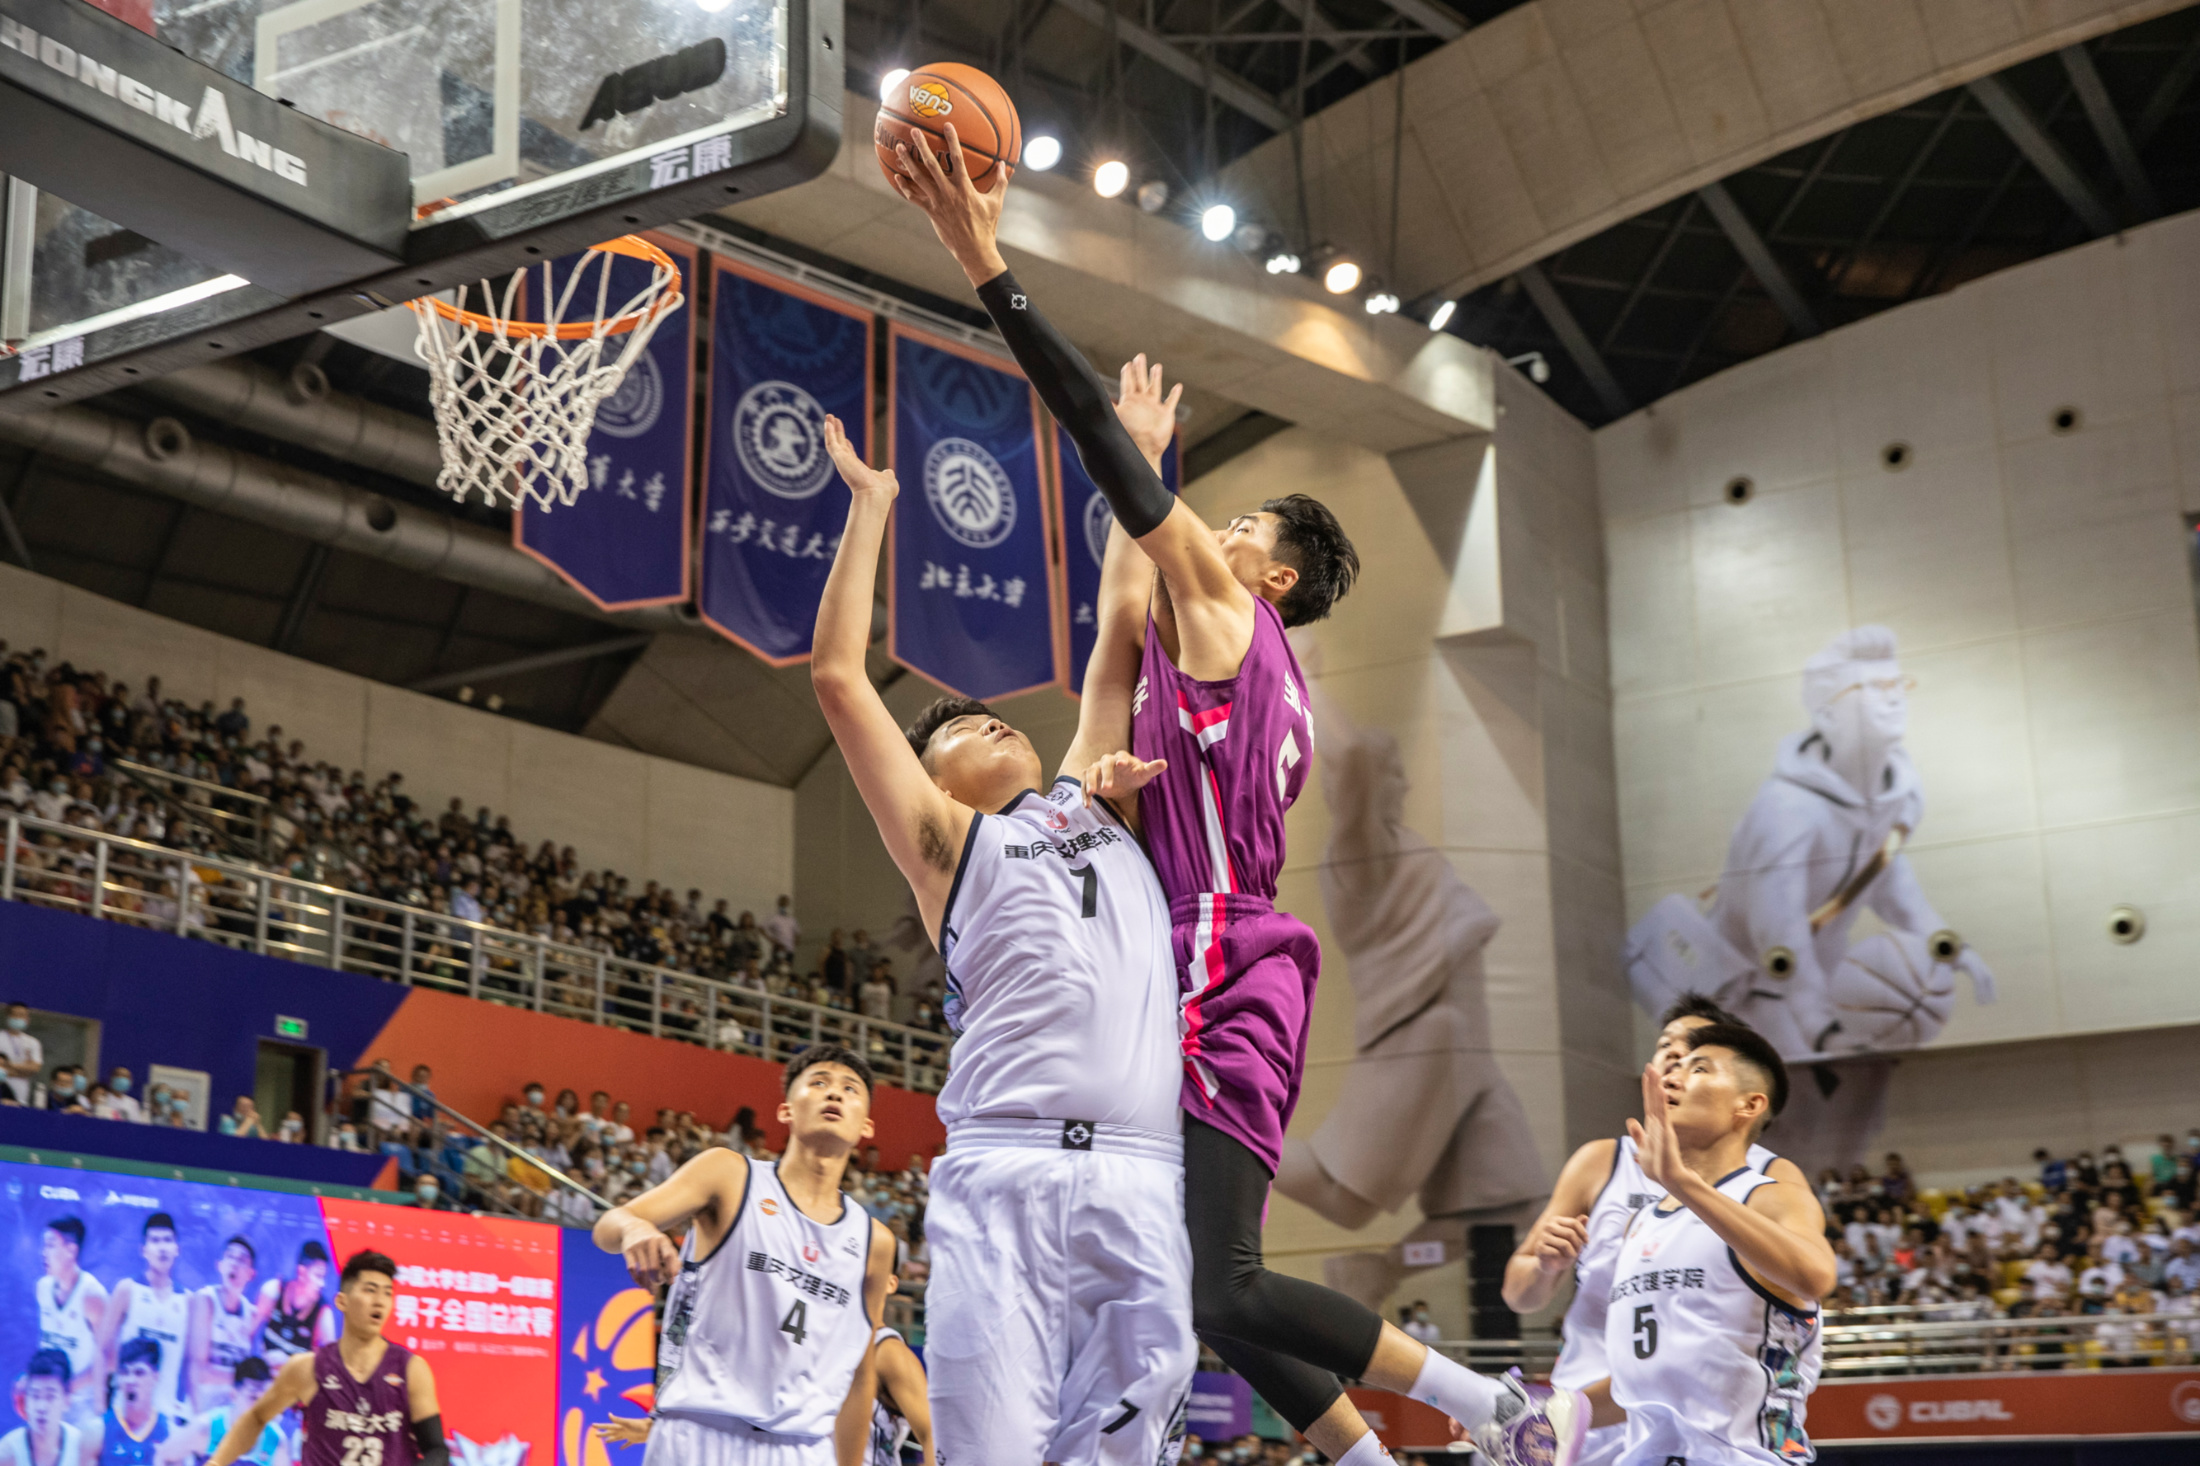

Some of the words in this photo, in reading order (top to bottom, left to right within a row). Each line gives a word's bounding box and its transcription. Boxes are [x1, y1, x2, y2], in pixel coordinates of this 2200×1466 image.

[0, 13, 308, 187] HONGKANG
[909, 85, 953, 116] CUBA
[779, 1298, 807, 1346] 4
[1632, 1304, 1658, 1360] 5
[1908, 1400, 2013, 1422] CUBAL
[339, 1436, 384, 1466] 23
